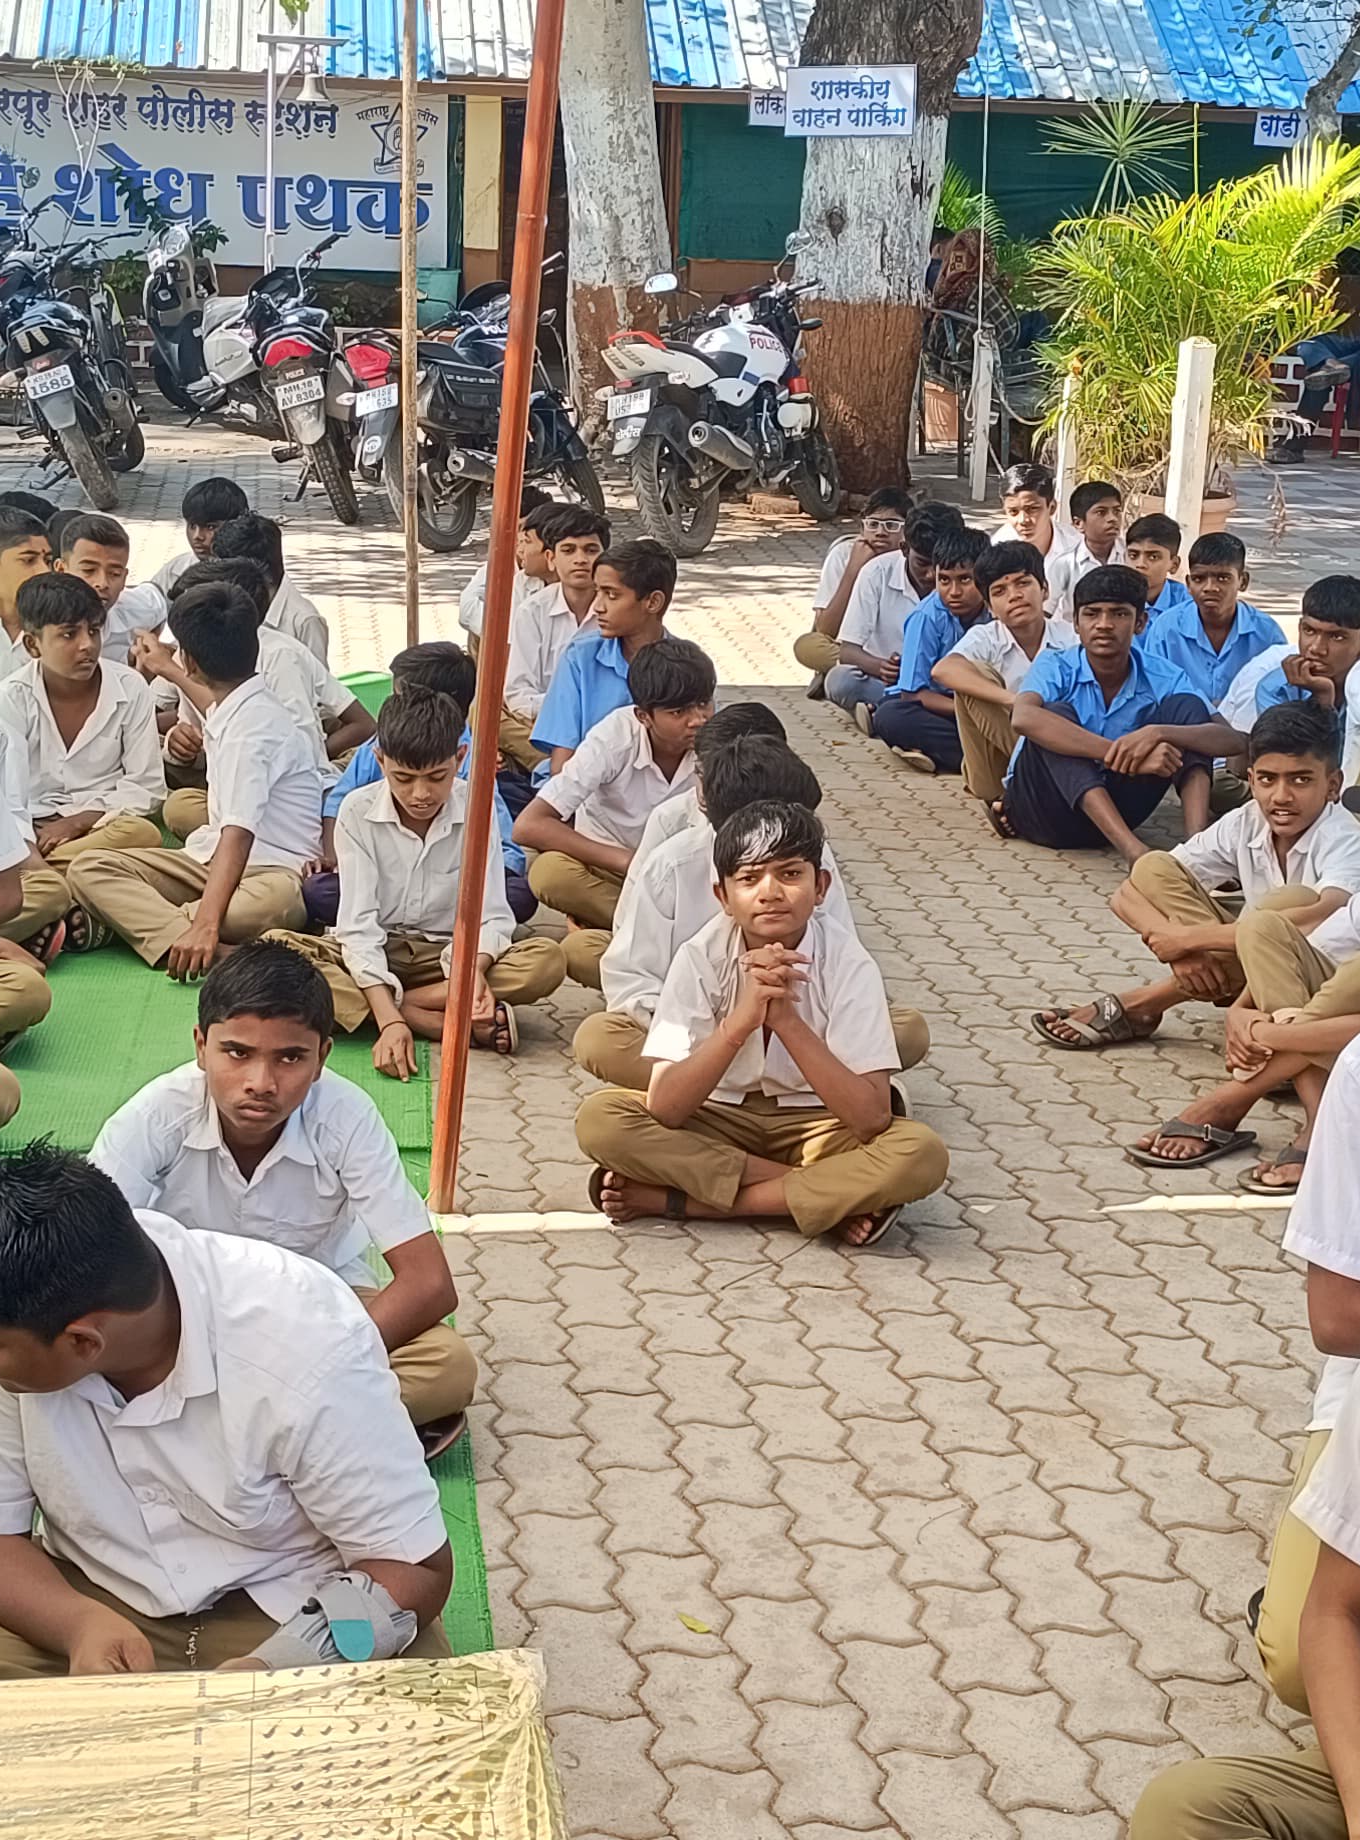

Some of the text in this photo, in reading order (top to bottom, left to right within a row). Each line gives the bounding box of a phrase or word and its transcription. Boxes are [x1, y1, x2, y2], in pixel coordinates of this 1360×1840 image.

[810, 75, 891, 101] शासकीय
[136, 84, 236, 135] पोलीस
[243, 99, 339, 140] स्टशन
[792, 101, 907, 129] वाहन पार्किंग
[1260, 112, 1301, 139] वाडी
[51, 142, 215, 228] शोध
[237, 174, 434, 239] पथक
[30, 374, 71, 397] 1585
